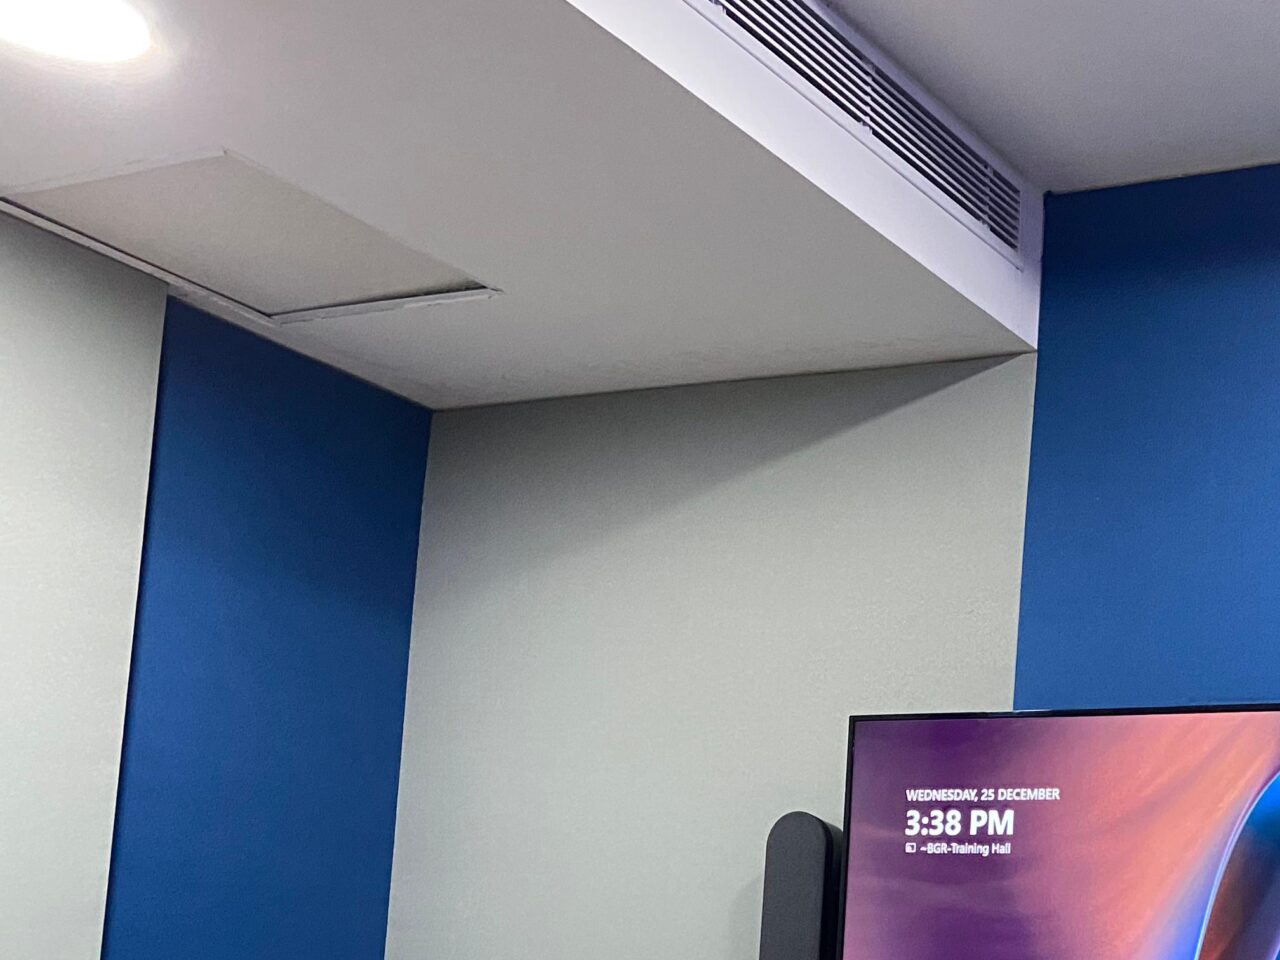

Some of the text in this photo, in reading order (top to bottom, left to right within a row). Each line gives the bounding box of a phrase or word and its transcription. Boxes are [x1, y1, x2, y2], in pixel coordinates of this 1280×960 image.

[906, 788, 1060, 802] WEDNESDAY, 25 DECEMBER
[905, 809, 1014, 836] 3:38 PM
[991, 843, 1011, 854] Hall
